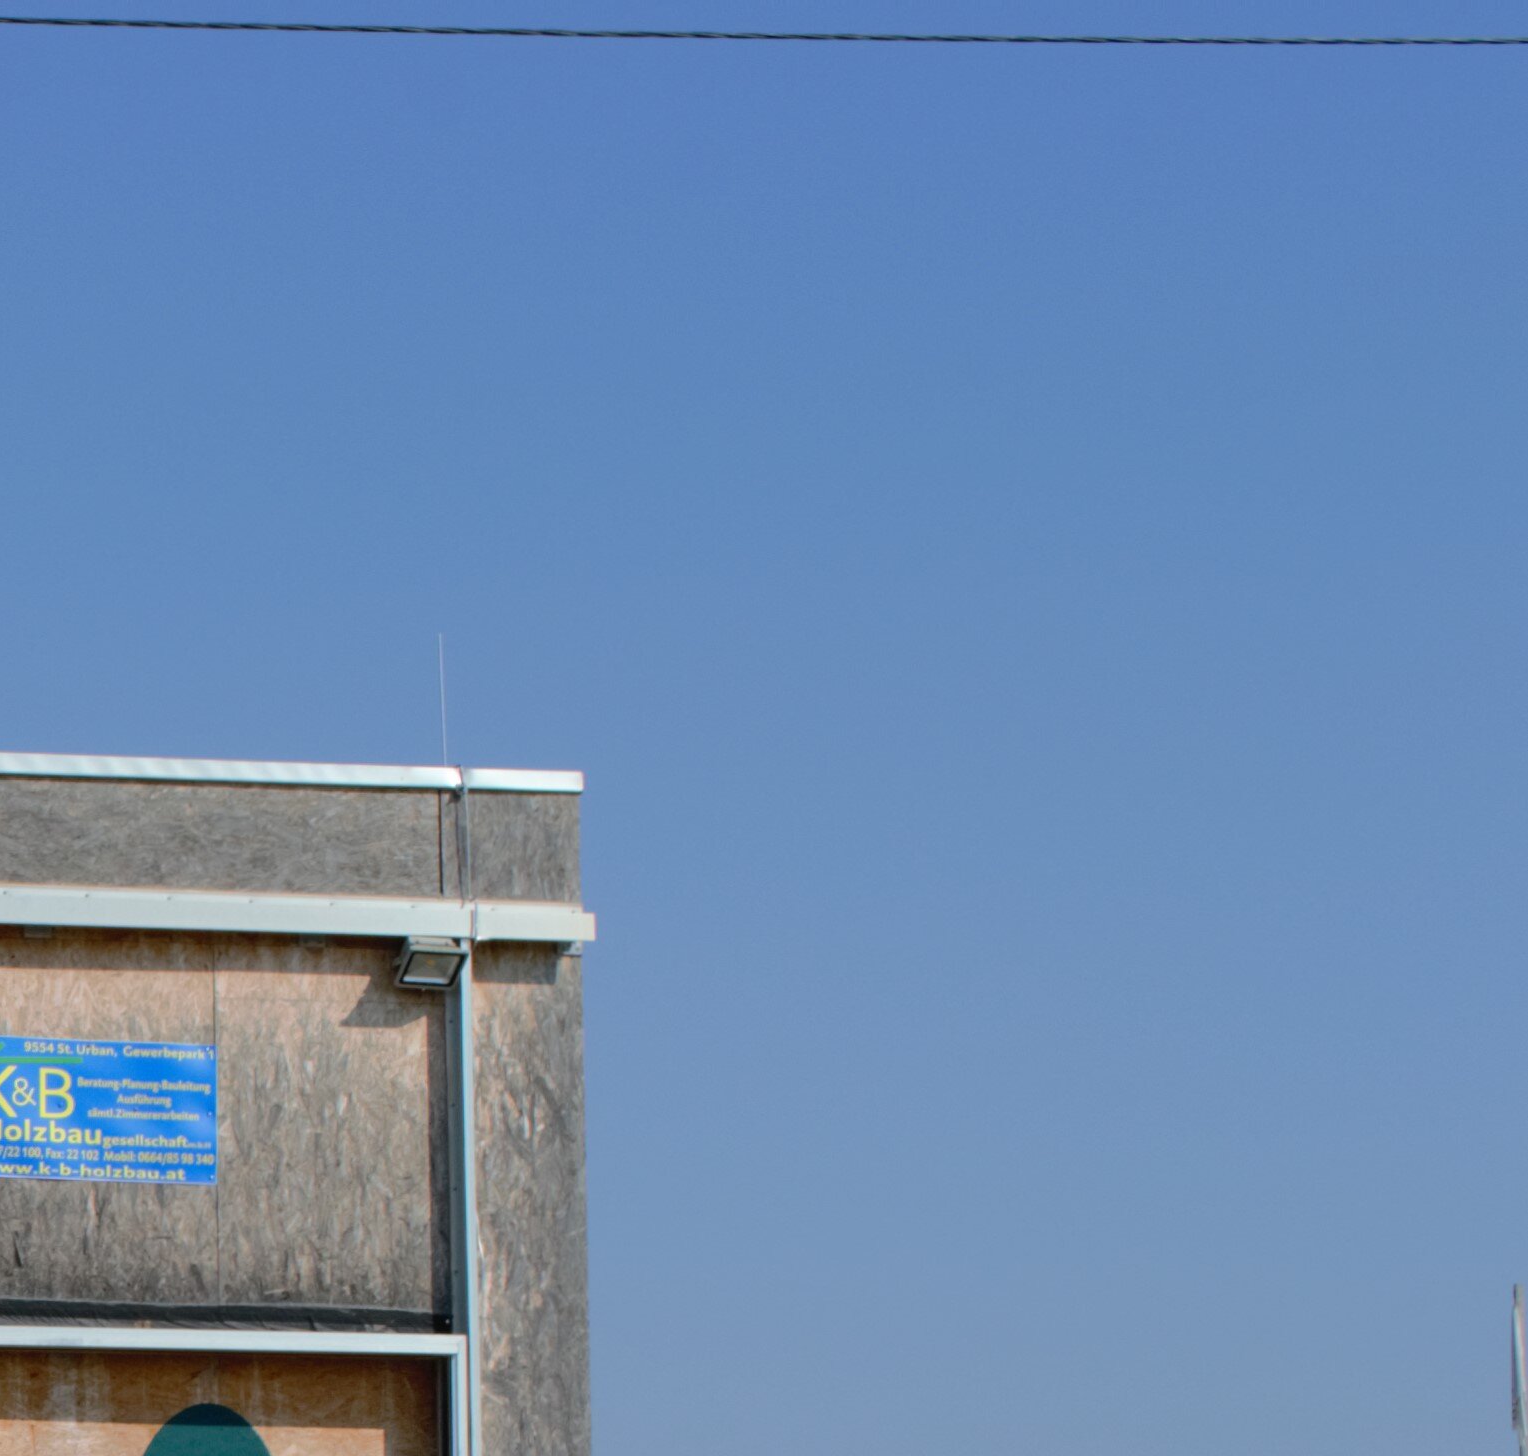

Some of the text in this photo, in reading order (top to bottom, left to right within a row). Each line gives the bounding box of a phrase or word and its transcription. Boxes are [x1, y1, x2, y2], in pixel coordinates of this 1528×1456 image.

[24, 1041, 54, 1054] 9554
[76, 1044, 118, 1058] Urban,
[124, 1045, 205, 1061] Gewerbepark
[117, 1093, 172, 1109] Ausführung
[66, 1149, 79, 1160] 22
